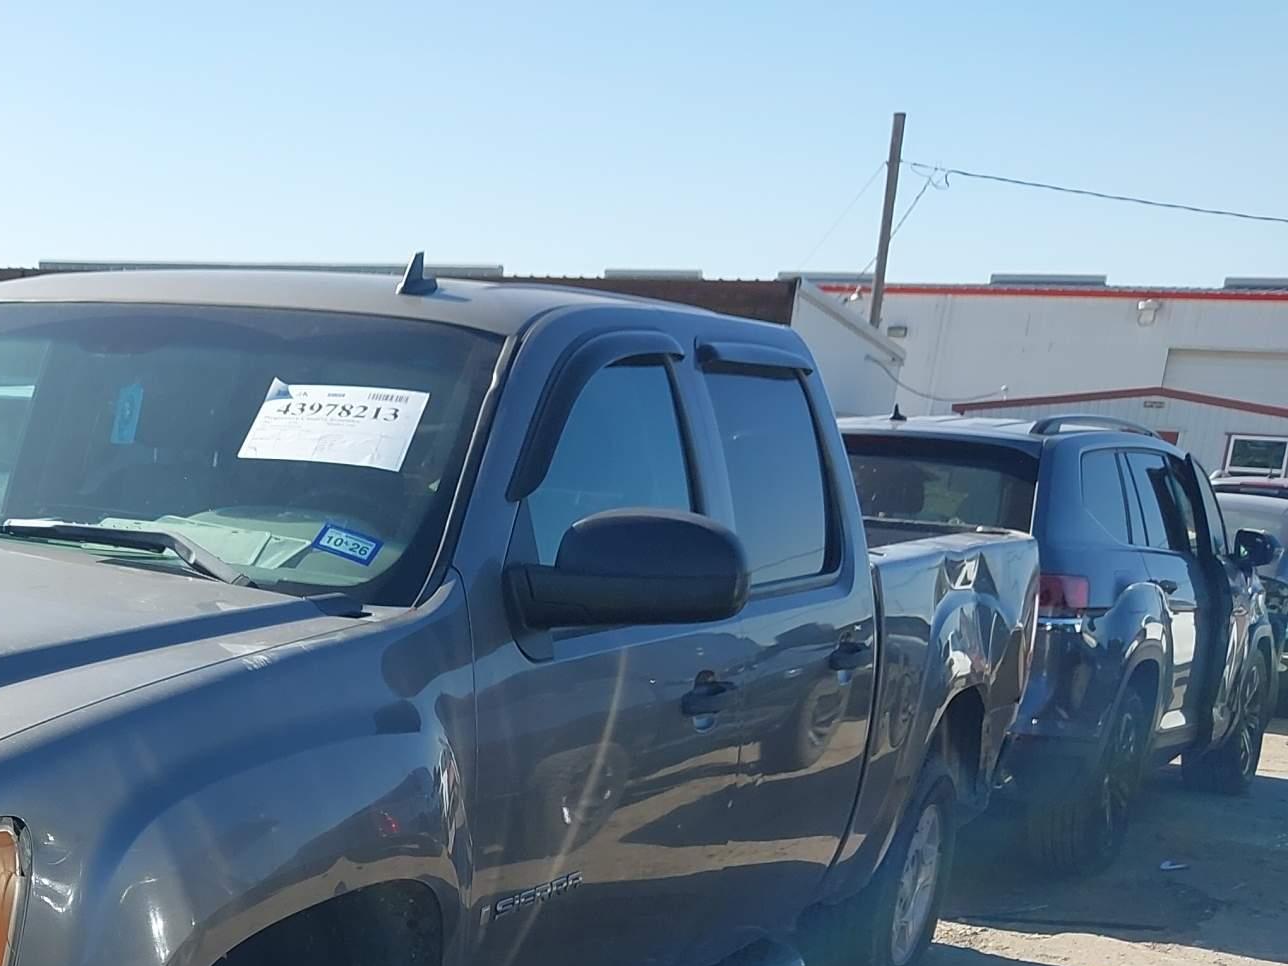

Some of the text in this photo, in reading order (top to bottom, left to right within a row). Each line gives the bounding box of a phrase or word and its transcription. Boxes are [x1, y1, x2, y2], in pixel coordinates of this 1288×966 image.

[276, 401, 401, 422] 43978213
[326, 535, 344, 547] 10
[348, 542, 370, 556] 26
